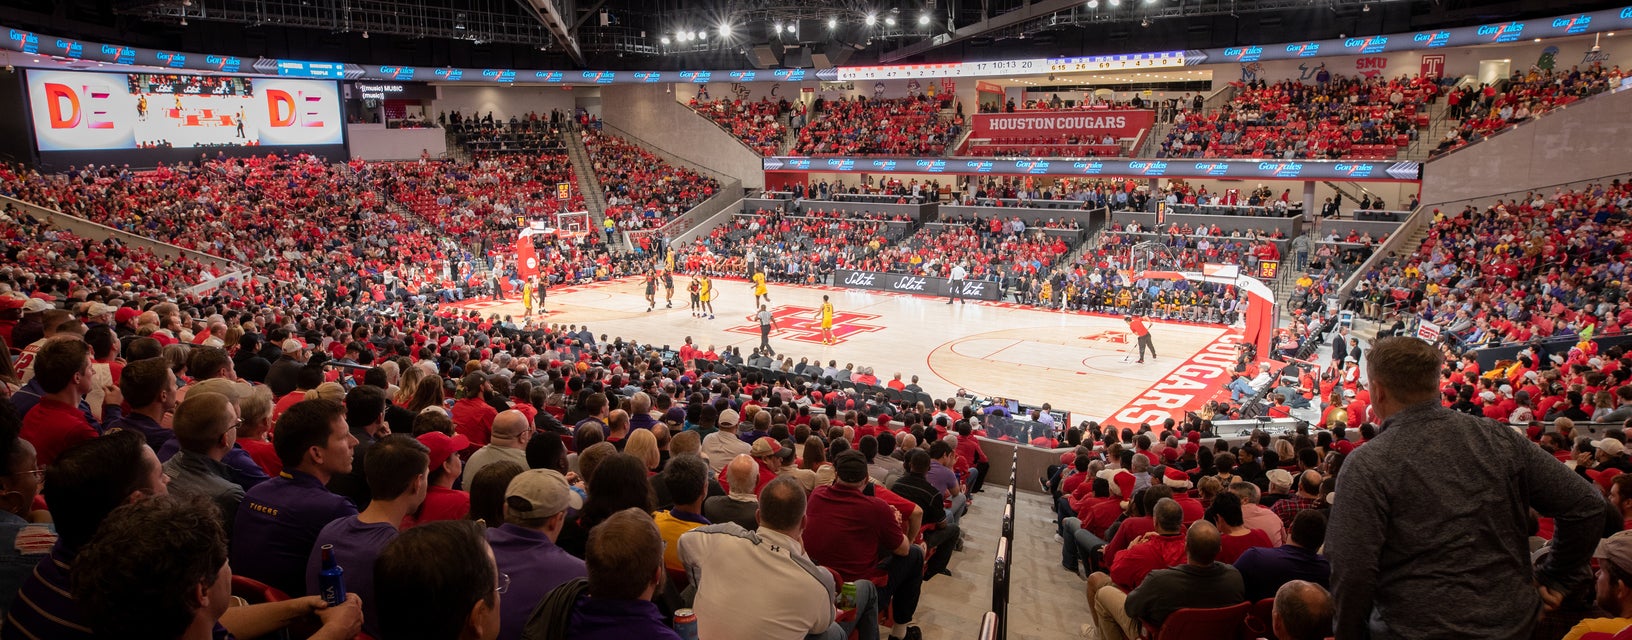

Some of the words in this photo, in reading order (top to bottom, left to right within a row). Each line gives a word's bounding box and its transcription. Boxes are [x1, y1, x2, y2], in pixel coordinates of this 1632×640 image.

[1477, 21, 1524, 40] Gonzales
[993, 60, 1017, 69] 10:13
[1021, 60, 1032, 69] 20
[1356, 57, 1387, 69] SMU
[989, 117, 1054, 130] HOUSTON
[1056, 116, 1126, 129] COUGARS
[1263, 269, 1273, 277] 26
[1115, 334, 1245, 426] COUGARS
[250, 502, 279, 516] TIGERS
